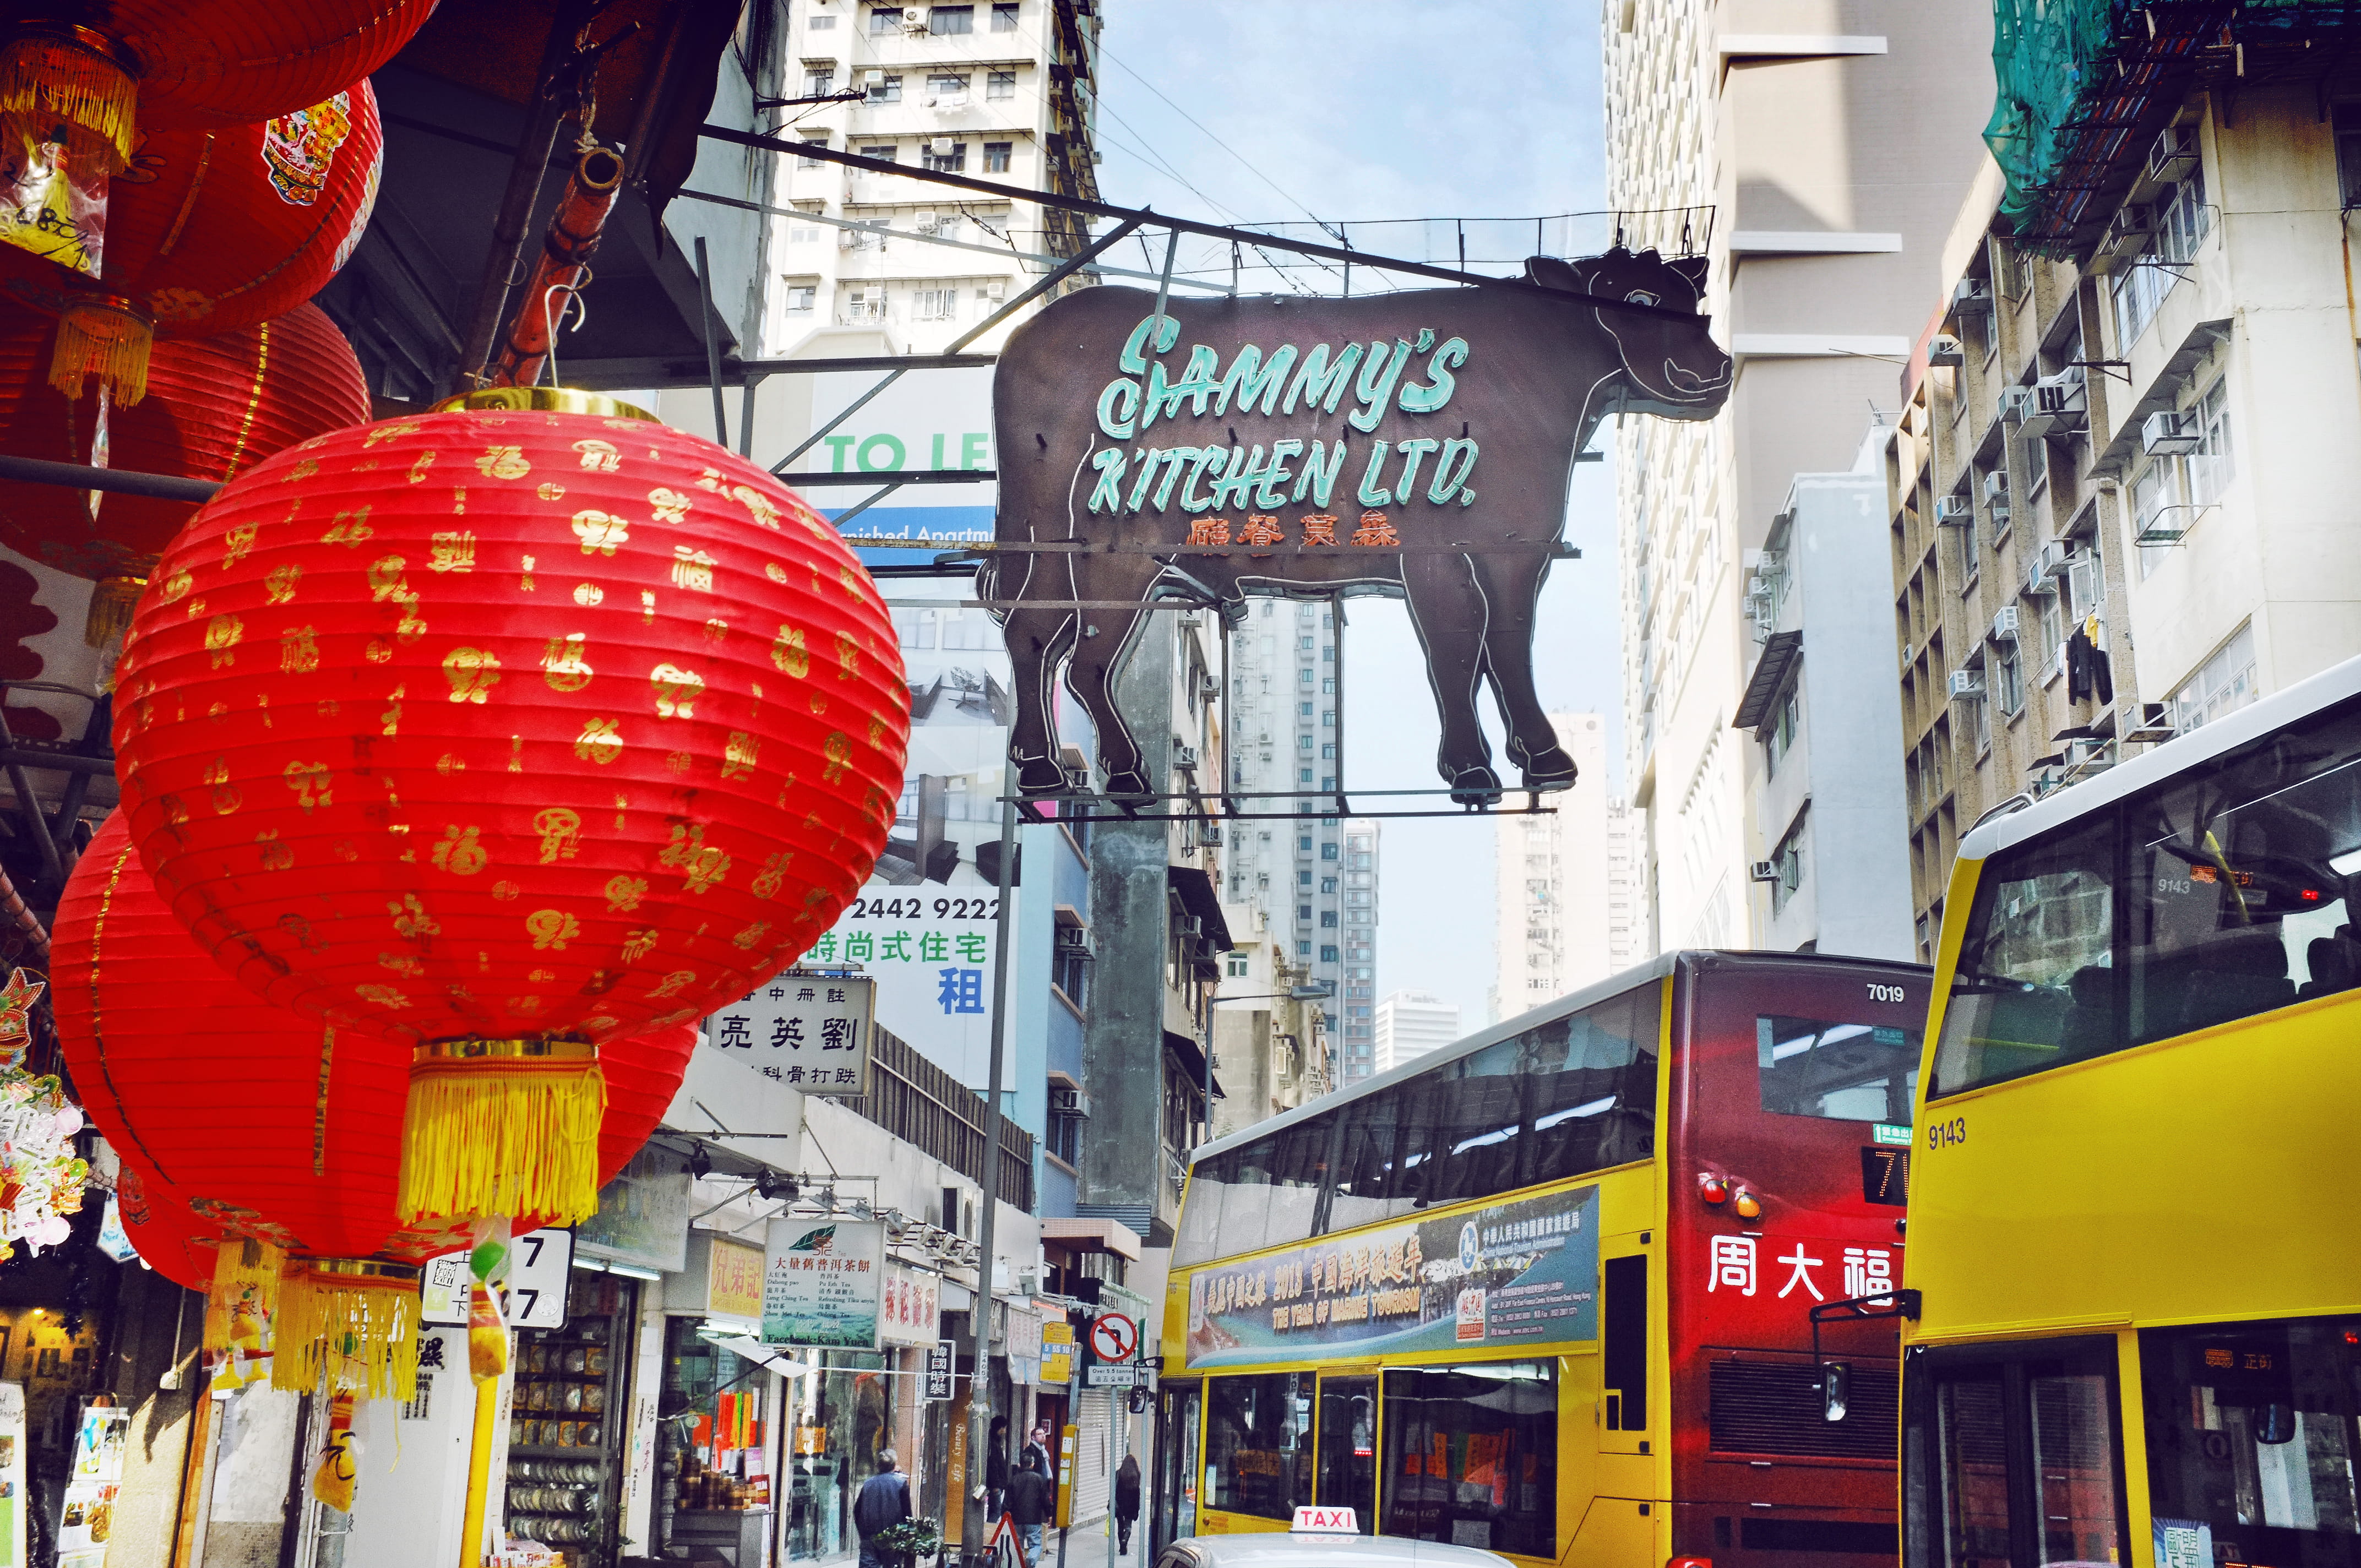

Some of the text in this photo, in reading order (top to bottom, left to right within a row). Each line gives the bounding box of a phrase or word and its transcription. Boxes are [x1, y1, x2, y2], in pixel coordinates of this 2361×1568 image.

[1097, 314, 1469, 440] SAMMY'S
[825, 433, 906, 472] TO
[1087, 437, 1479, 515] KITCHEN LTD.
[2158, 879, 2190, 894] 9143
[851, 898, 922, 919] 2442
[806, 930, 987, 963] 時尚式住宅
[938, 967, 985, 1015] 租
[1867, 983, 1905, 1003] 7019
[1928, 1117, 1966, 1151] 9143
[523, 1237, 545, 1267] 7
[775, 1256, 871, 1273] 大量舊普洱茶餅
[1708, 1234, 1894, 1307] 周大福
[518, 1289, 539, 1320] 7
[1301, 1510, 1351, 1527] TAXI
